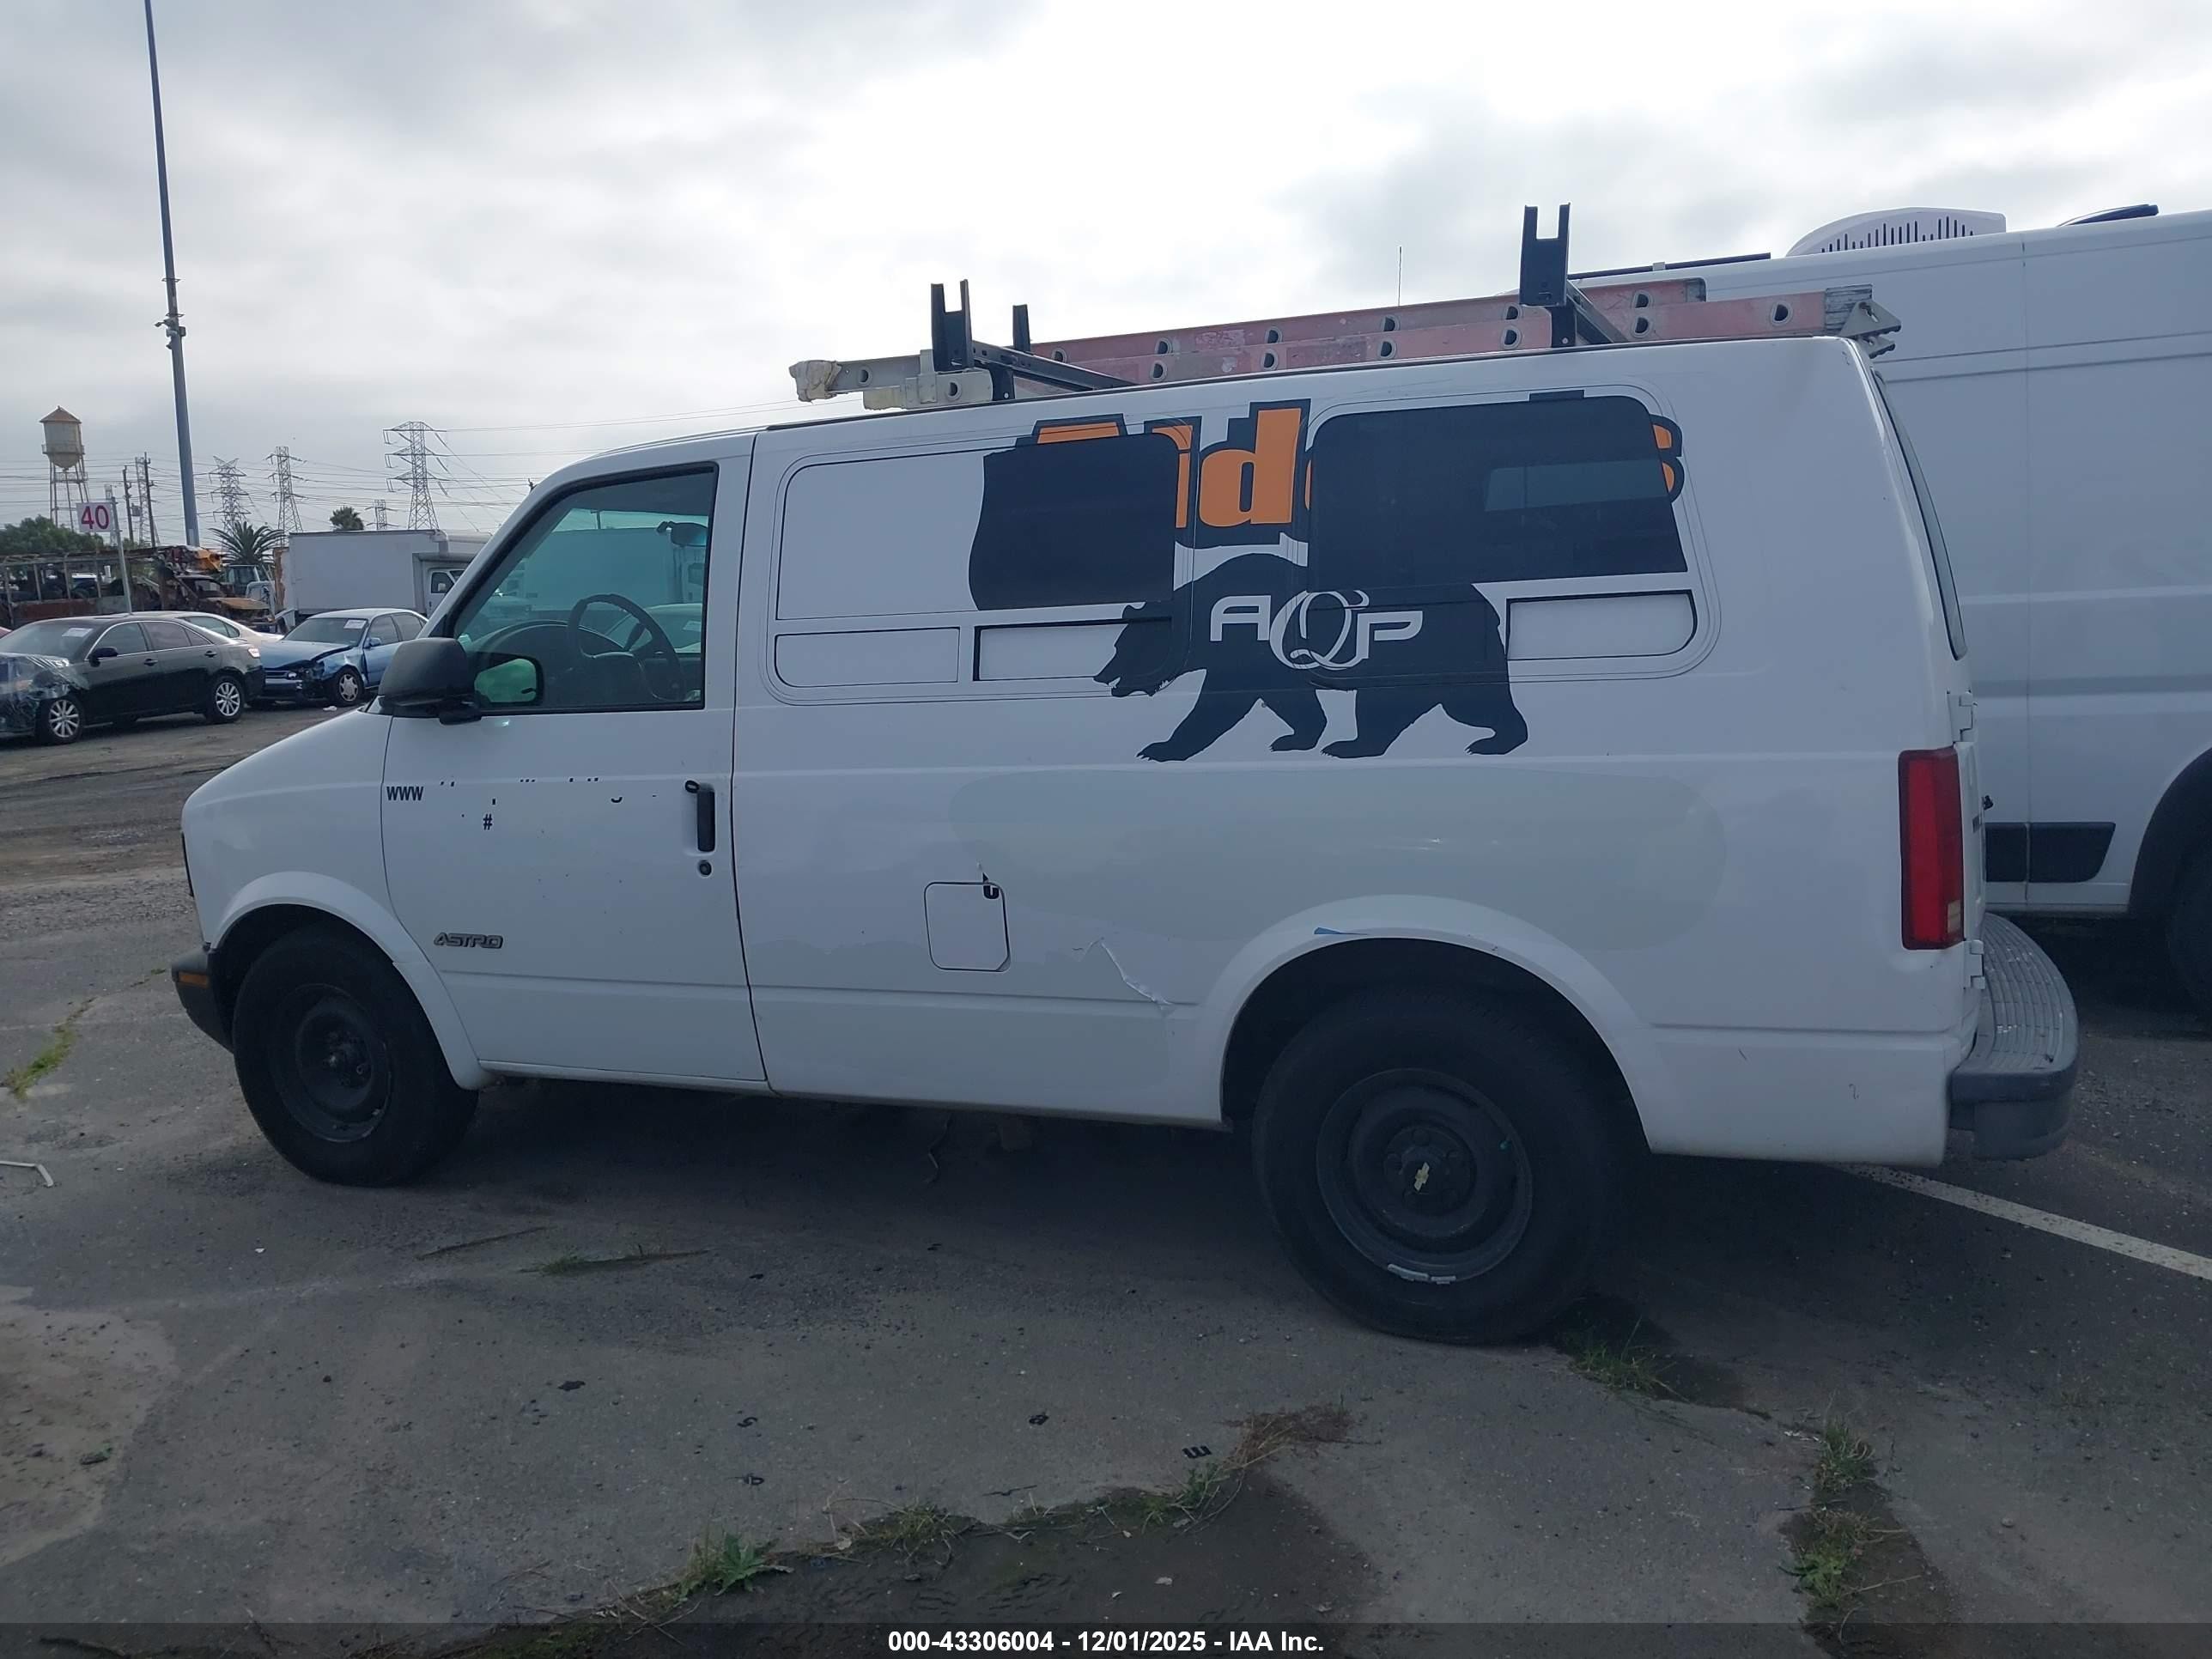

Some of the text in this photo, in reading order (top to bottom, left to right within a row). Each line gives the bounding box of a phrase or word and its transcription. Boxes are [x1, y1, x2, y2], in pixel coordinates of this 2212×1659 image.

[81, 504, 109, 530] 40
[1209, 589, 1424, 671] AQP
[433, 932, 504, 950] ASTRO
